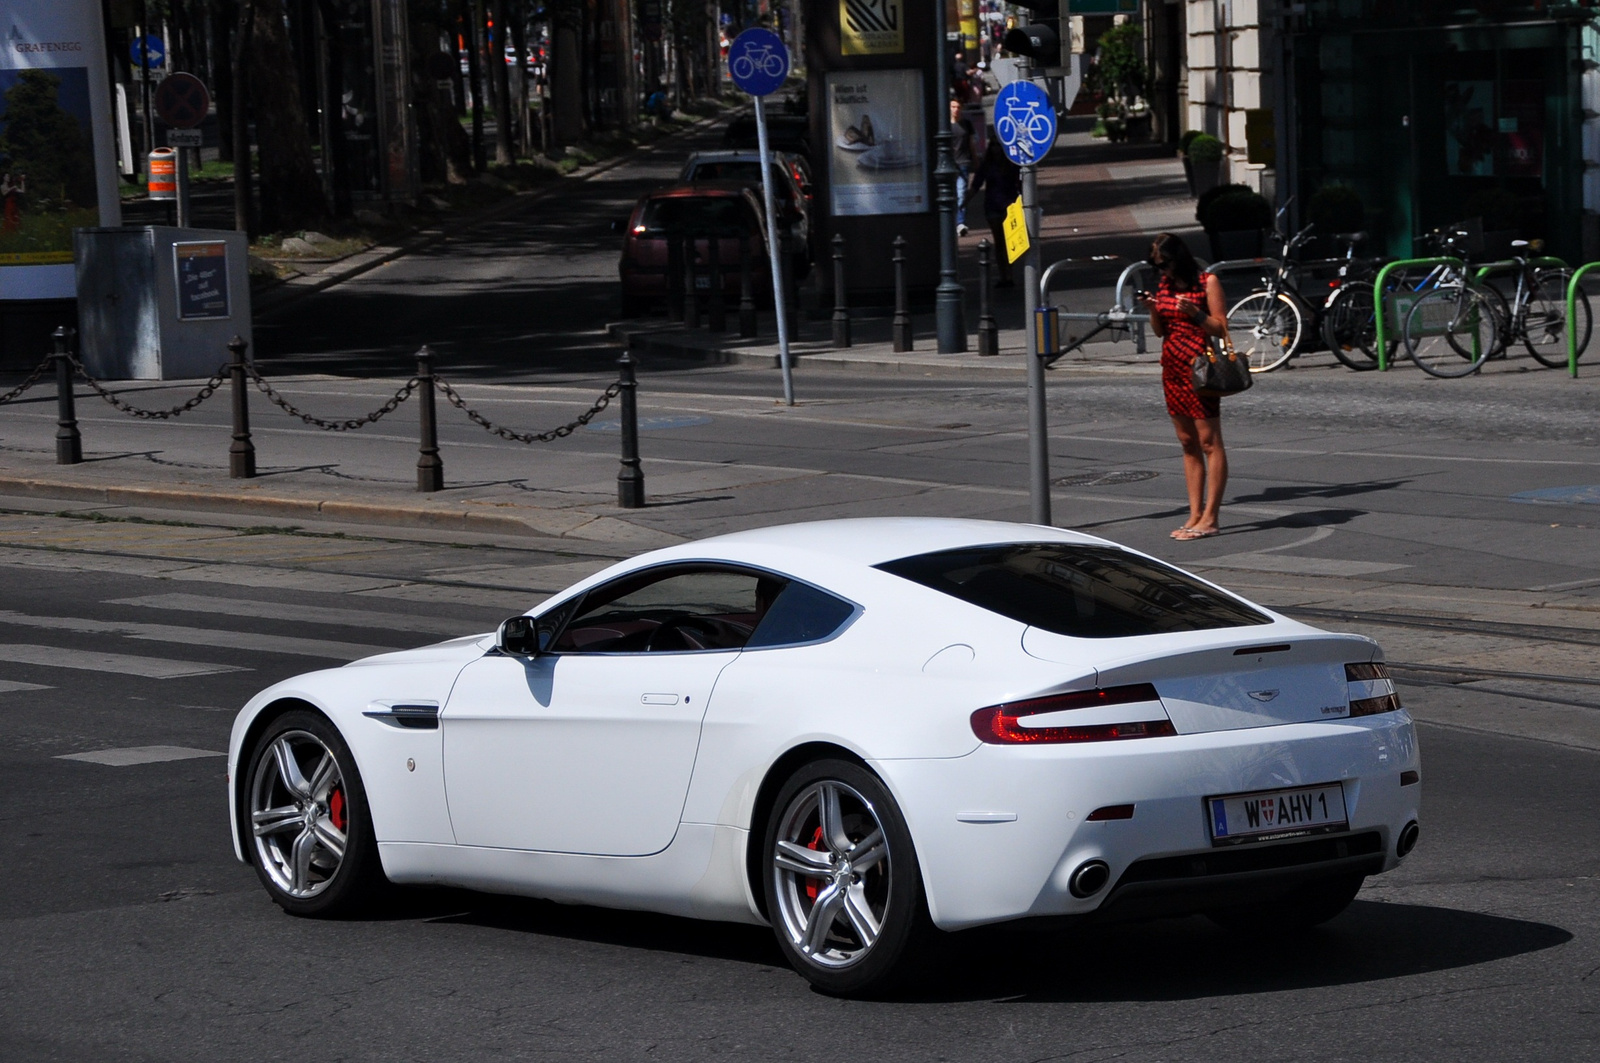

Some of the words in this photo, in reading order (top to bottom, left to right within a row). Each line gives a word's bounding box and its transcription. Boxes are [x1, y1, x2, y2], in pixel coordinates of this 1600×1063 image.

[16, 42, 82, 53] GRAFENEGG
[1244, 799, 1260, 828] W
[1278, 793, 1312, 825] AHV
[1318, 792, 1328, 819] 1
[1218, 822, 1225, 831] A
